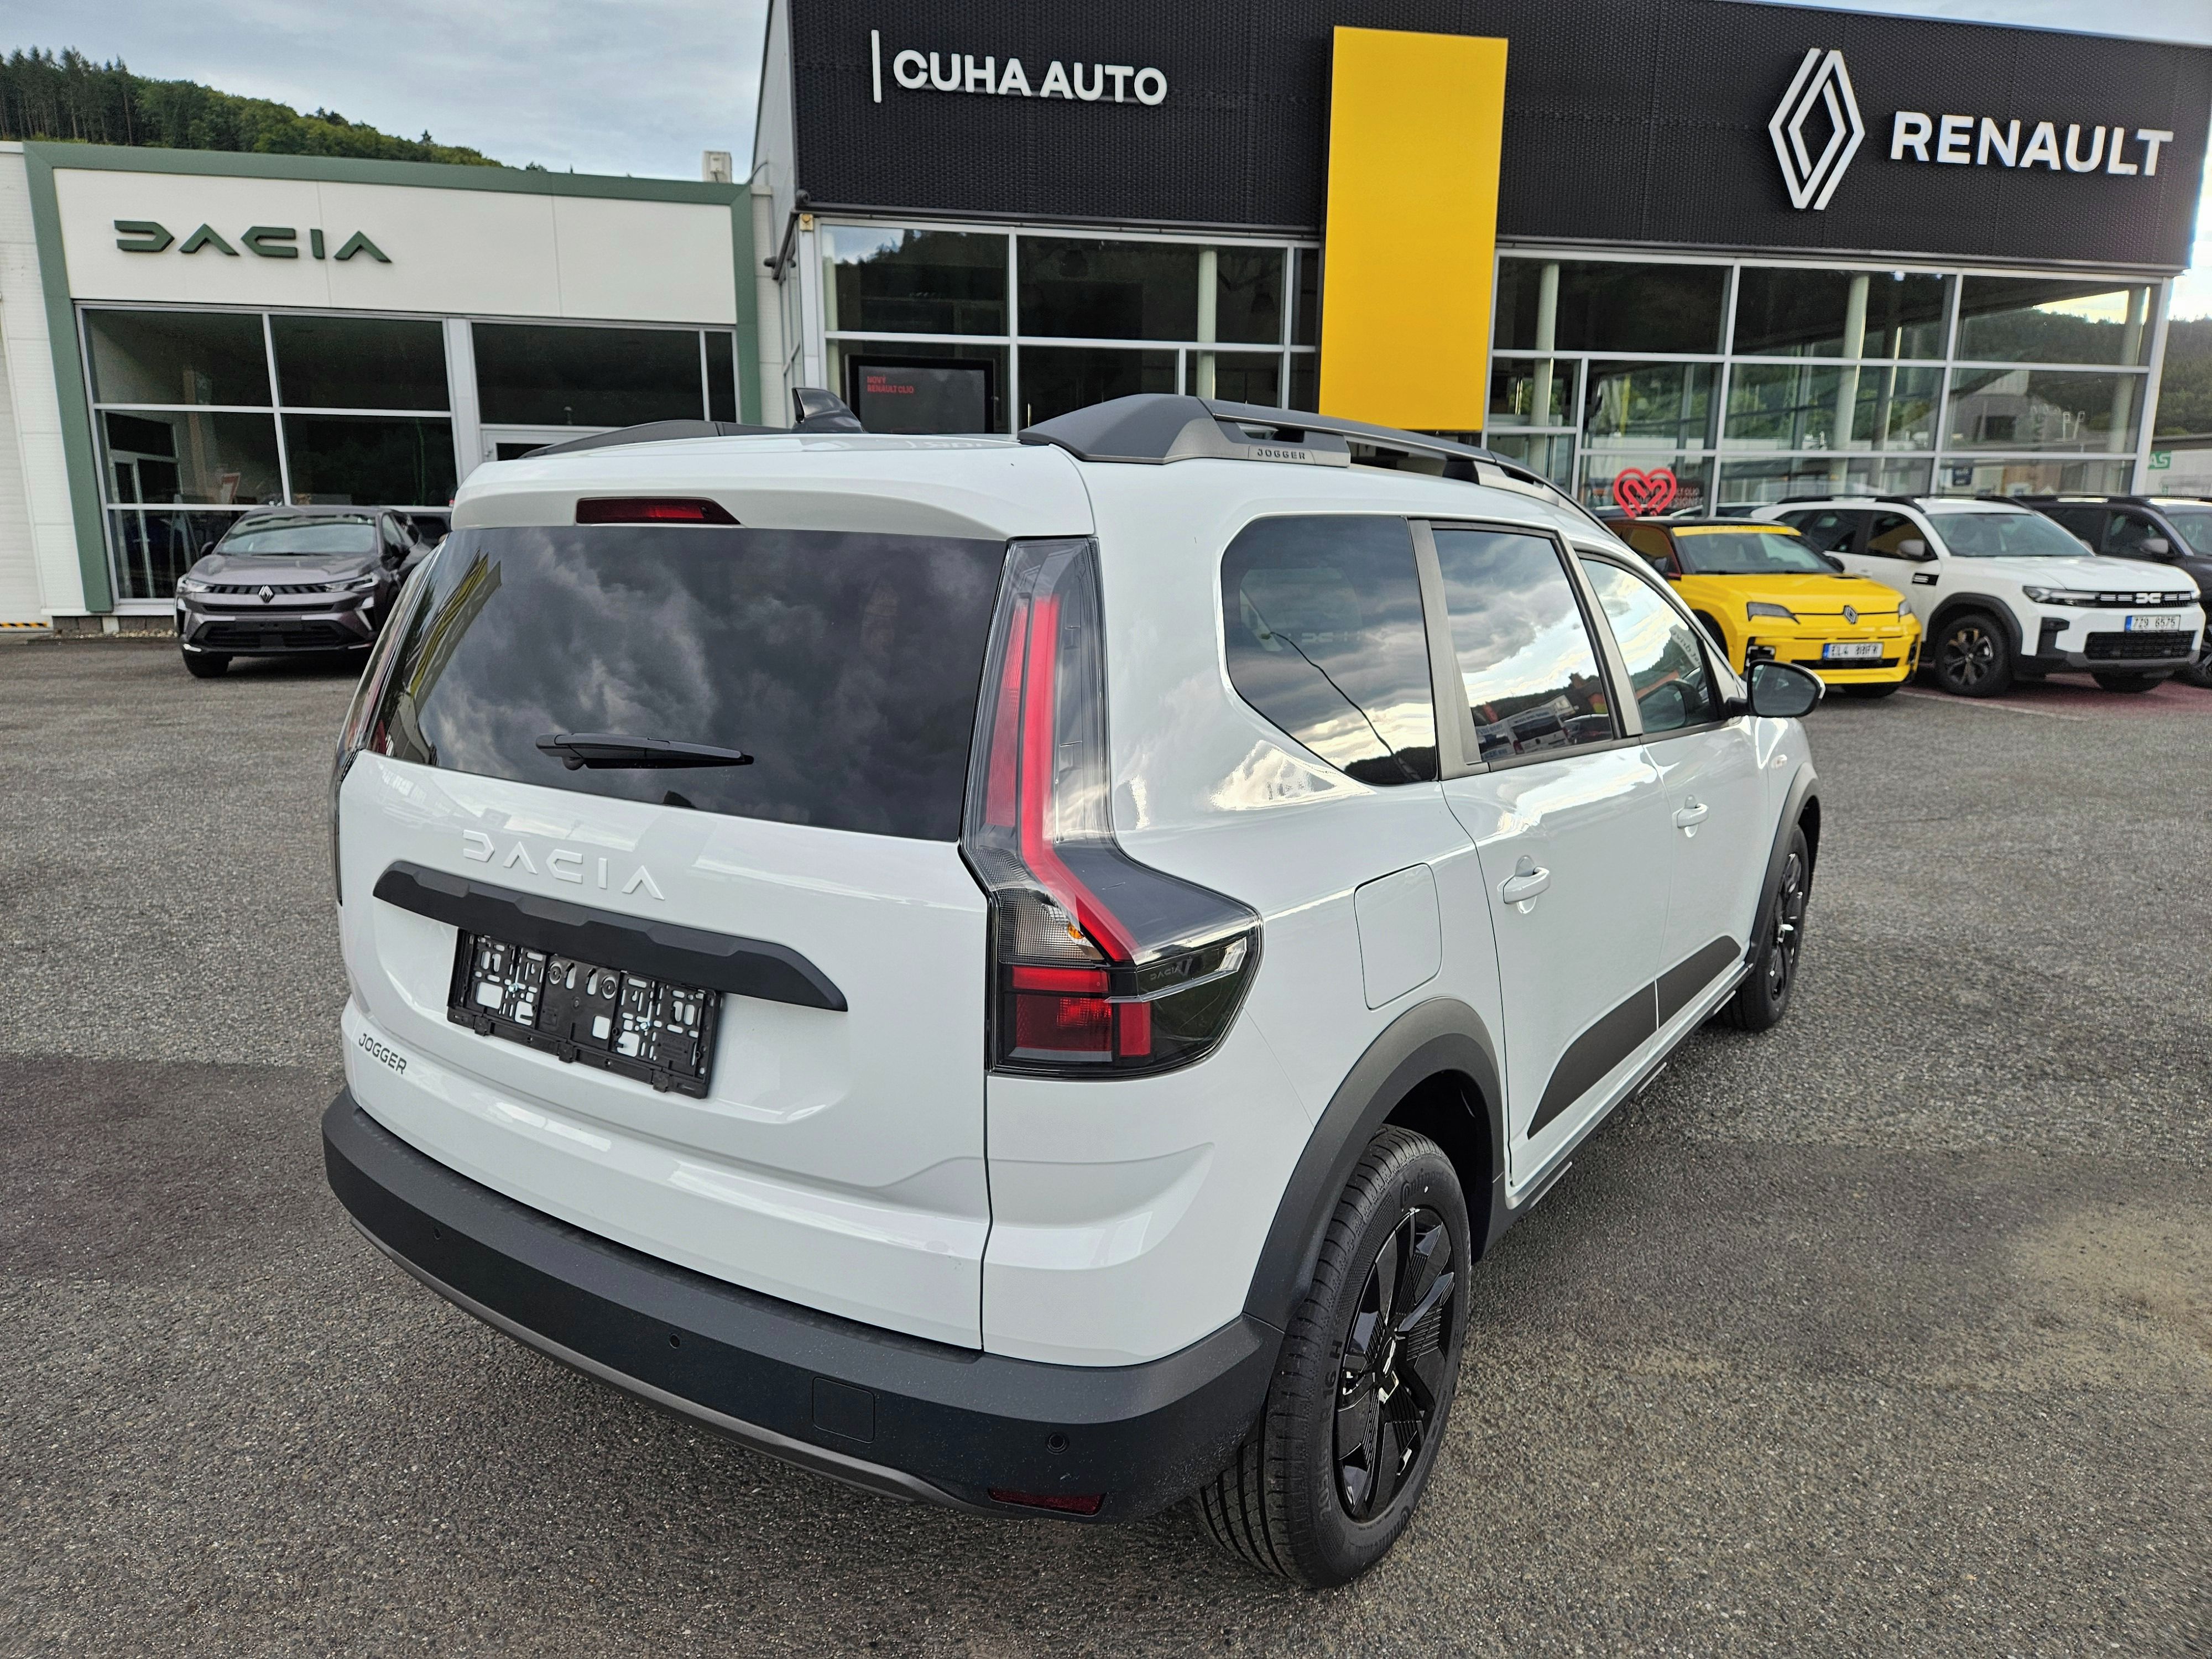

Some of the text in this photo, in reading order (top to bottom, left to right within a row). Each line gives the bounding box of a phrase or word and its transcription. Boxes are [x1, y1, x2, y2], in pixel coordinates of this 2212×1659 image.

[893, 49, 1167, 106] CUHA AUTO
[1890, 111, 2174, 176] RENAULT
[114, 219, 392, 263] DACIA
[898, 385, 914, 394] CLIO
[1257, 448, 1306, 460] JOGGER
[463, 830, 665, 901] DACIA
[358, 1032, 407, 1075] JOGGER
[1329, 1340, 1343, 1360] H
